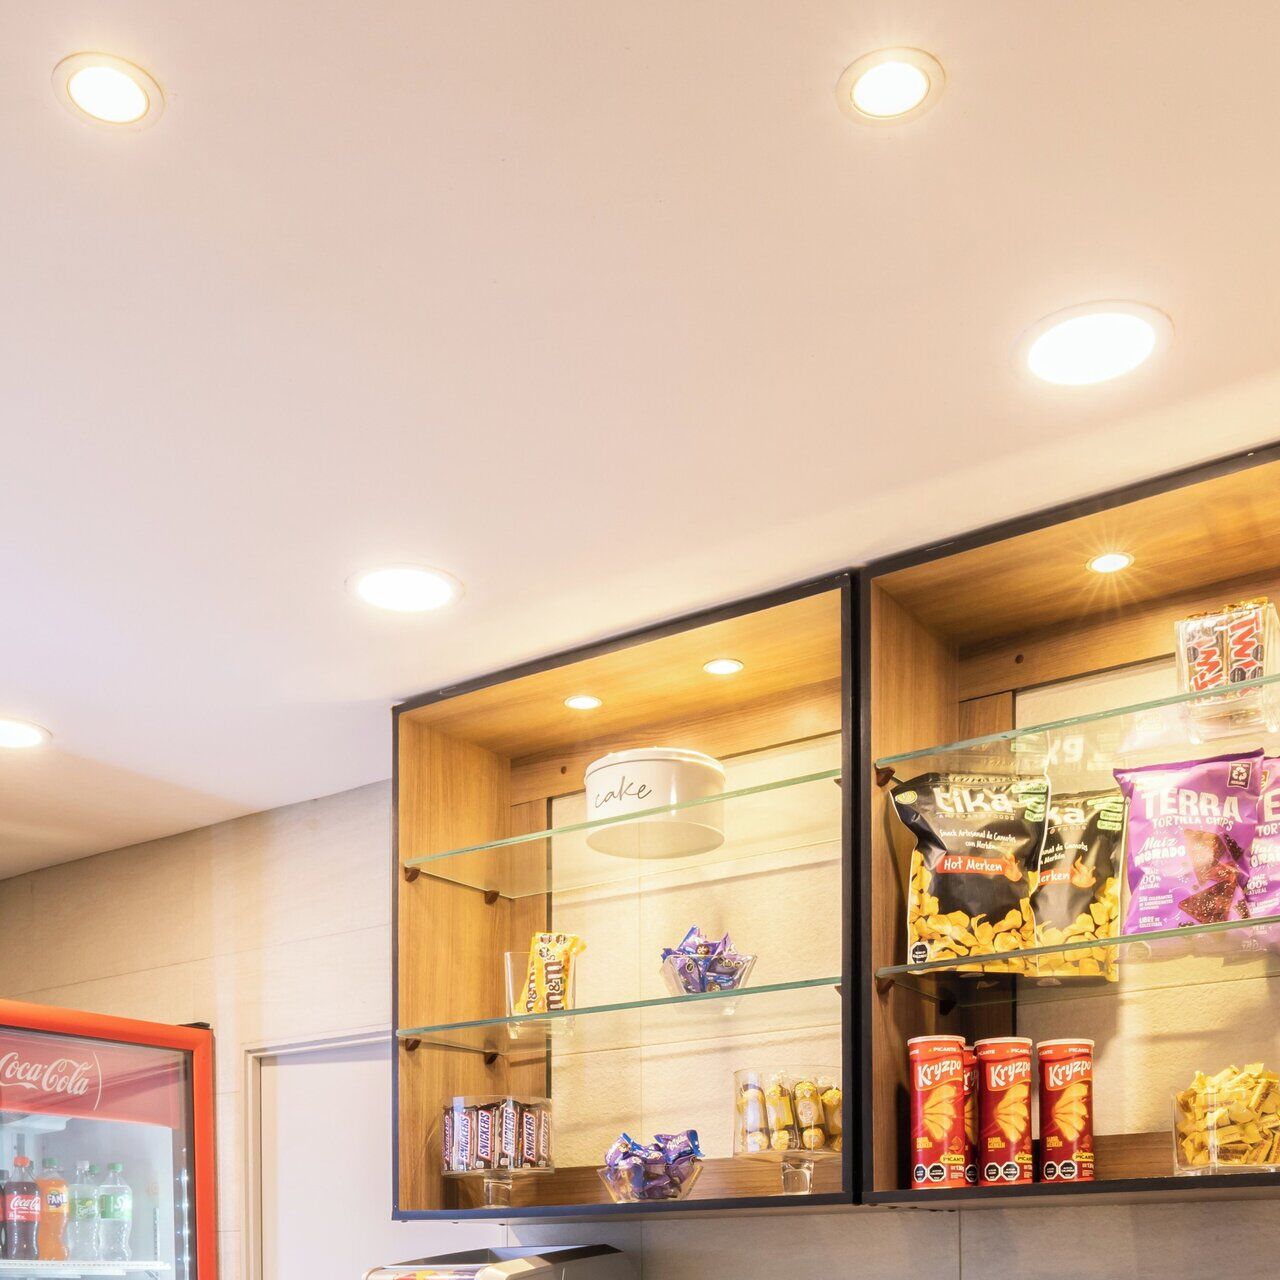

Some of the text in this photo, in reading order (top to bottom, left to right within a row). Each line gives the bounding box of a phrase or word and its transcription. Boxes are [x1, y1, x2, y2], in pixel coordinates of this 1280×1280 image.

[1229, 609, 1264, 672] TWI
[595, 776, 652, 808] cake
[933, 784, 1014, 813] tika
[1141, 787, 1243, 823] TERRA
[1152, 815, 1234, 832] TORTILLA CHIPS
[943, 857, 1003, 872] Hot Merken
[1134, 845, 1186, 867] MORADO
[1040, 869, 1070, 883] erken
[918, 1059, 962, 1087] Kryzpo
[990, 1062, 1031, 1088] Kryzpo
[1049, 1061, 1092, 1087] Kryzpo
[479, 1112, 491, 1157] SNICKERS
[525, 1114, 535, 1158] SNICKERS
